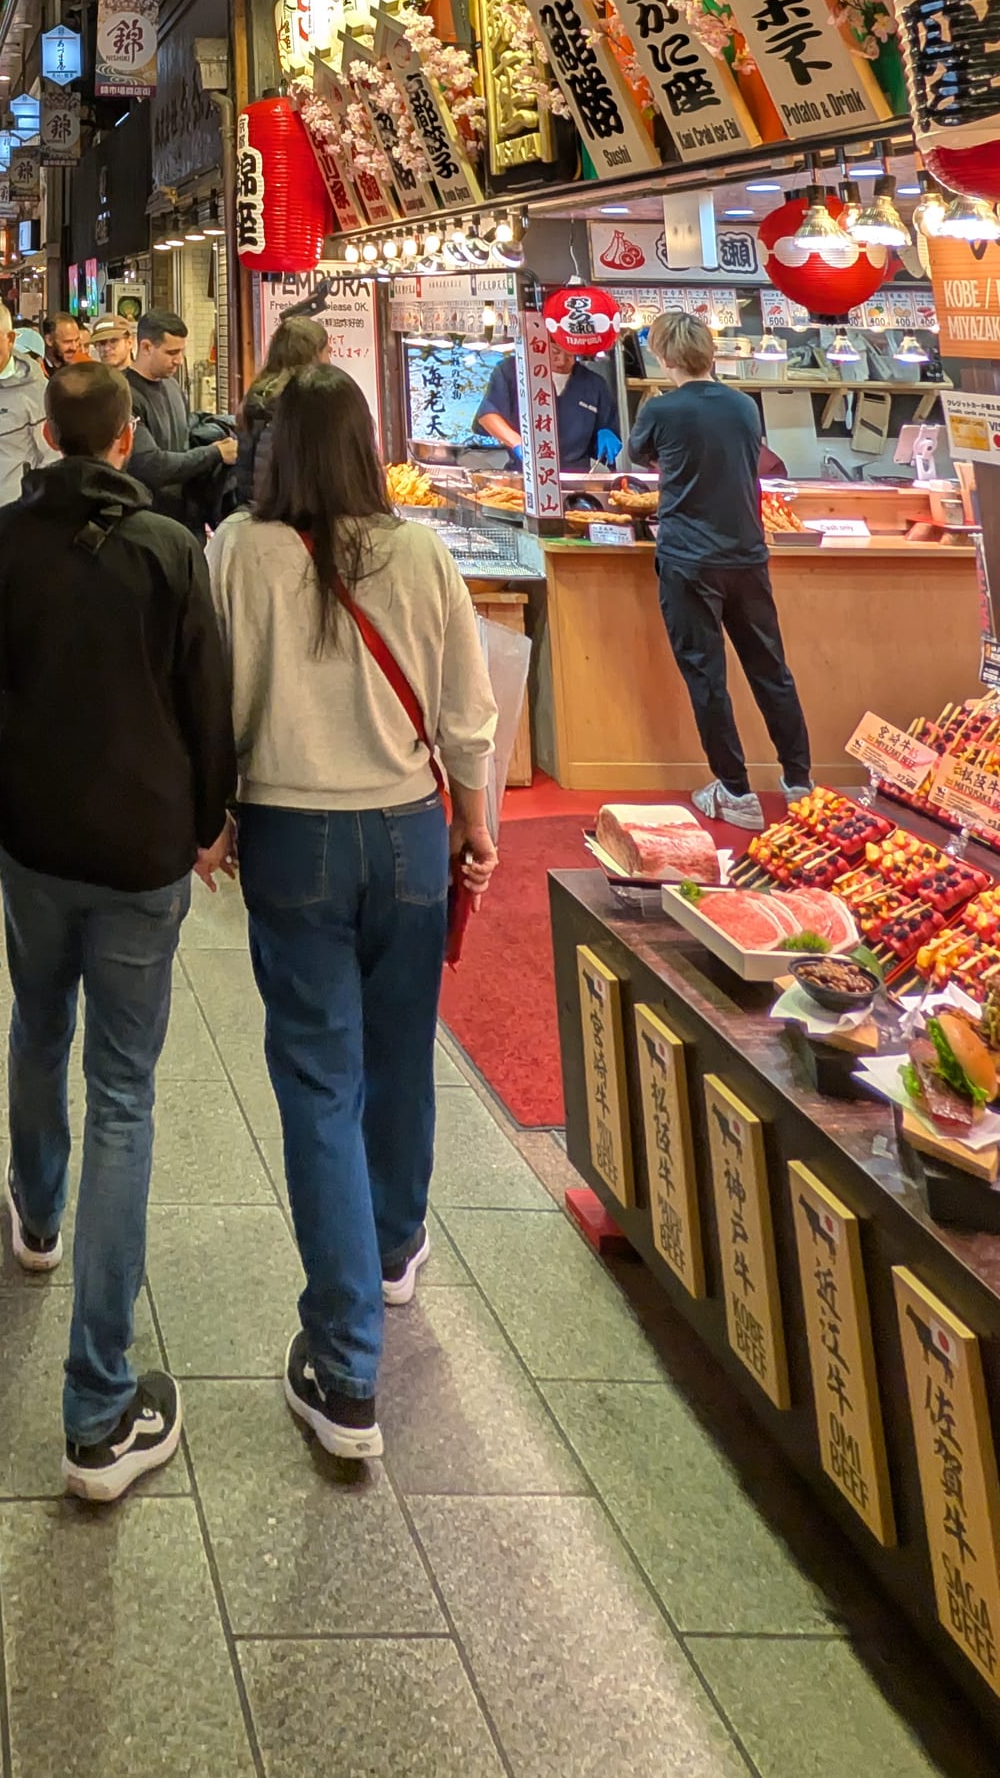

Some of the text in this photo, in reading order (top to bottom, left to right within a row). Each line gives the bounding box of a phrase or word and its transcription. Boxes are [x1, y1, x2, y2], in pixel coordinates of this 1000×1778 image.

[106, 18, 145, 64] 錦
[46, 113, 72, 144] 錦
[781, 88, 866, 127] Potato & Drink
[603, 145, 632, 167] Sushi
[943, 279, 981, 309] KOBE
[520, 413, 533, 483] MATCHA
[877, 724, 911, 752] 宮崎牛
[723, 1158, 756, 1298] 神戸牛
[732, 1289, 765, 1346] KOBE
[813, 1259, 854, 1416] 近江牛
[735, 1321, 768, 1381] BEEF
[829, 1410, 862, 1473] OMI
[924, 1375, 978, 1565] 佐賀牛
[828, 1443, 870, 1512] BEEF
[942, 1551, 995, 1643] SAGA
[948, 1592, 998, 1680] BEEF
